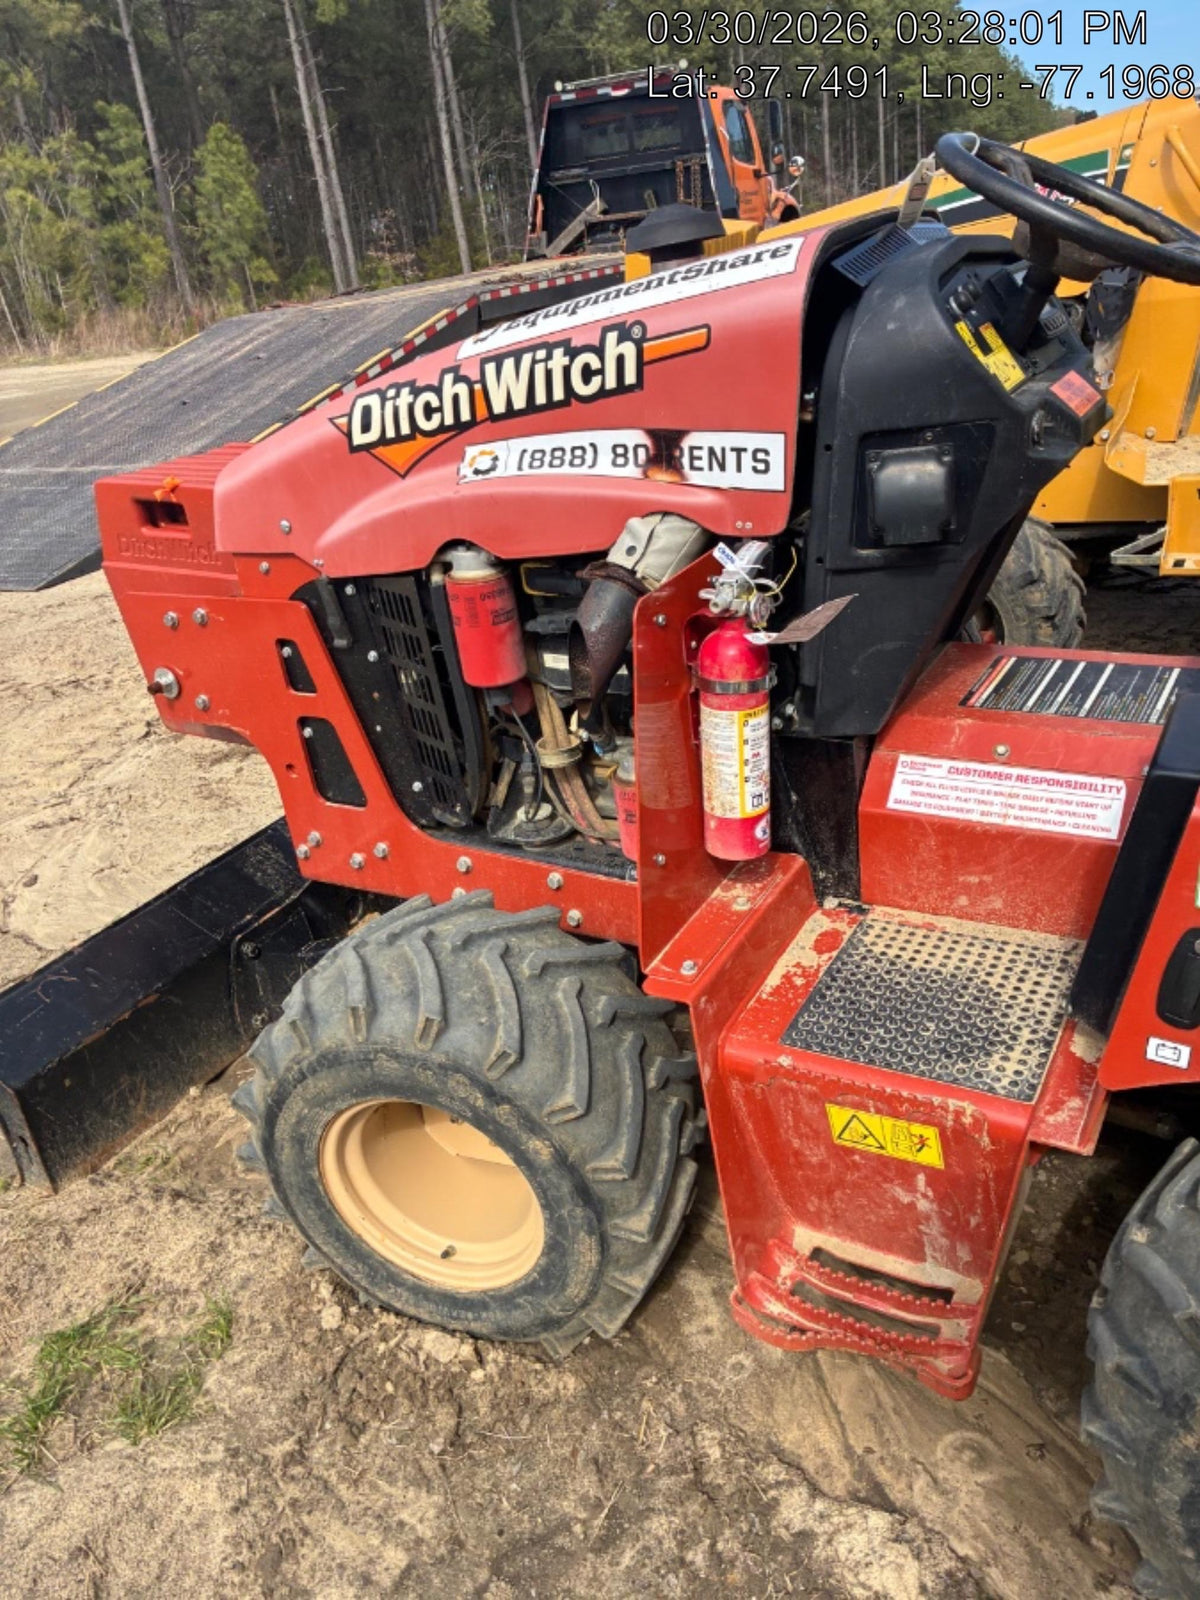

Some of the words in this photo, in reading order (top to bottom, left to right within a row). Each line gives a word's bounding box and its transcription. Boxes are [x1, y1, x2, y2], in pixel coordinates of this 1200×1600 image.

[502, 243, 794, 334] EquipmentShare
[349, 373, 472, 447] Ditch
[516, 443, 598, 472] (888)
[947, 765, 1013, 783] CUSTOMER
[1014, 772, 1124, 794] RESPONSIBILITY
